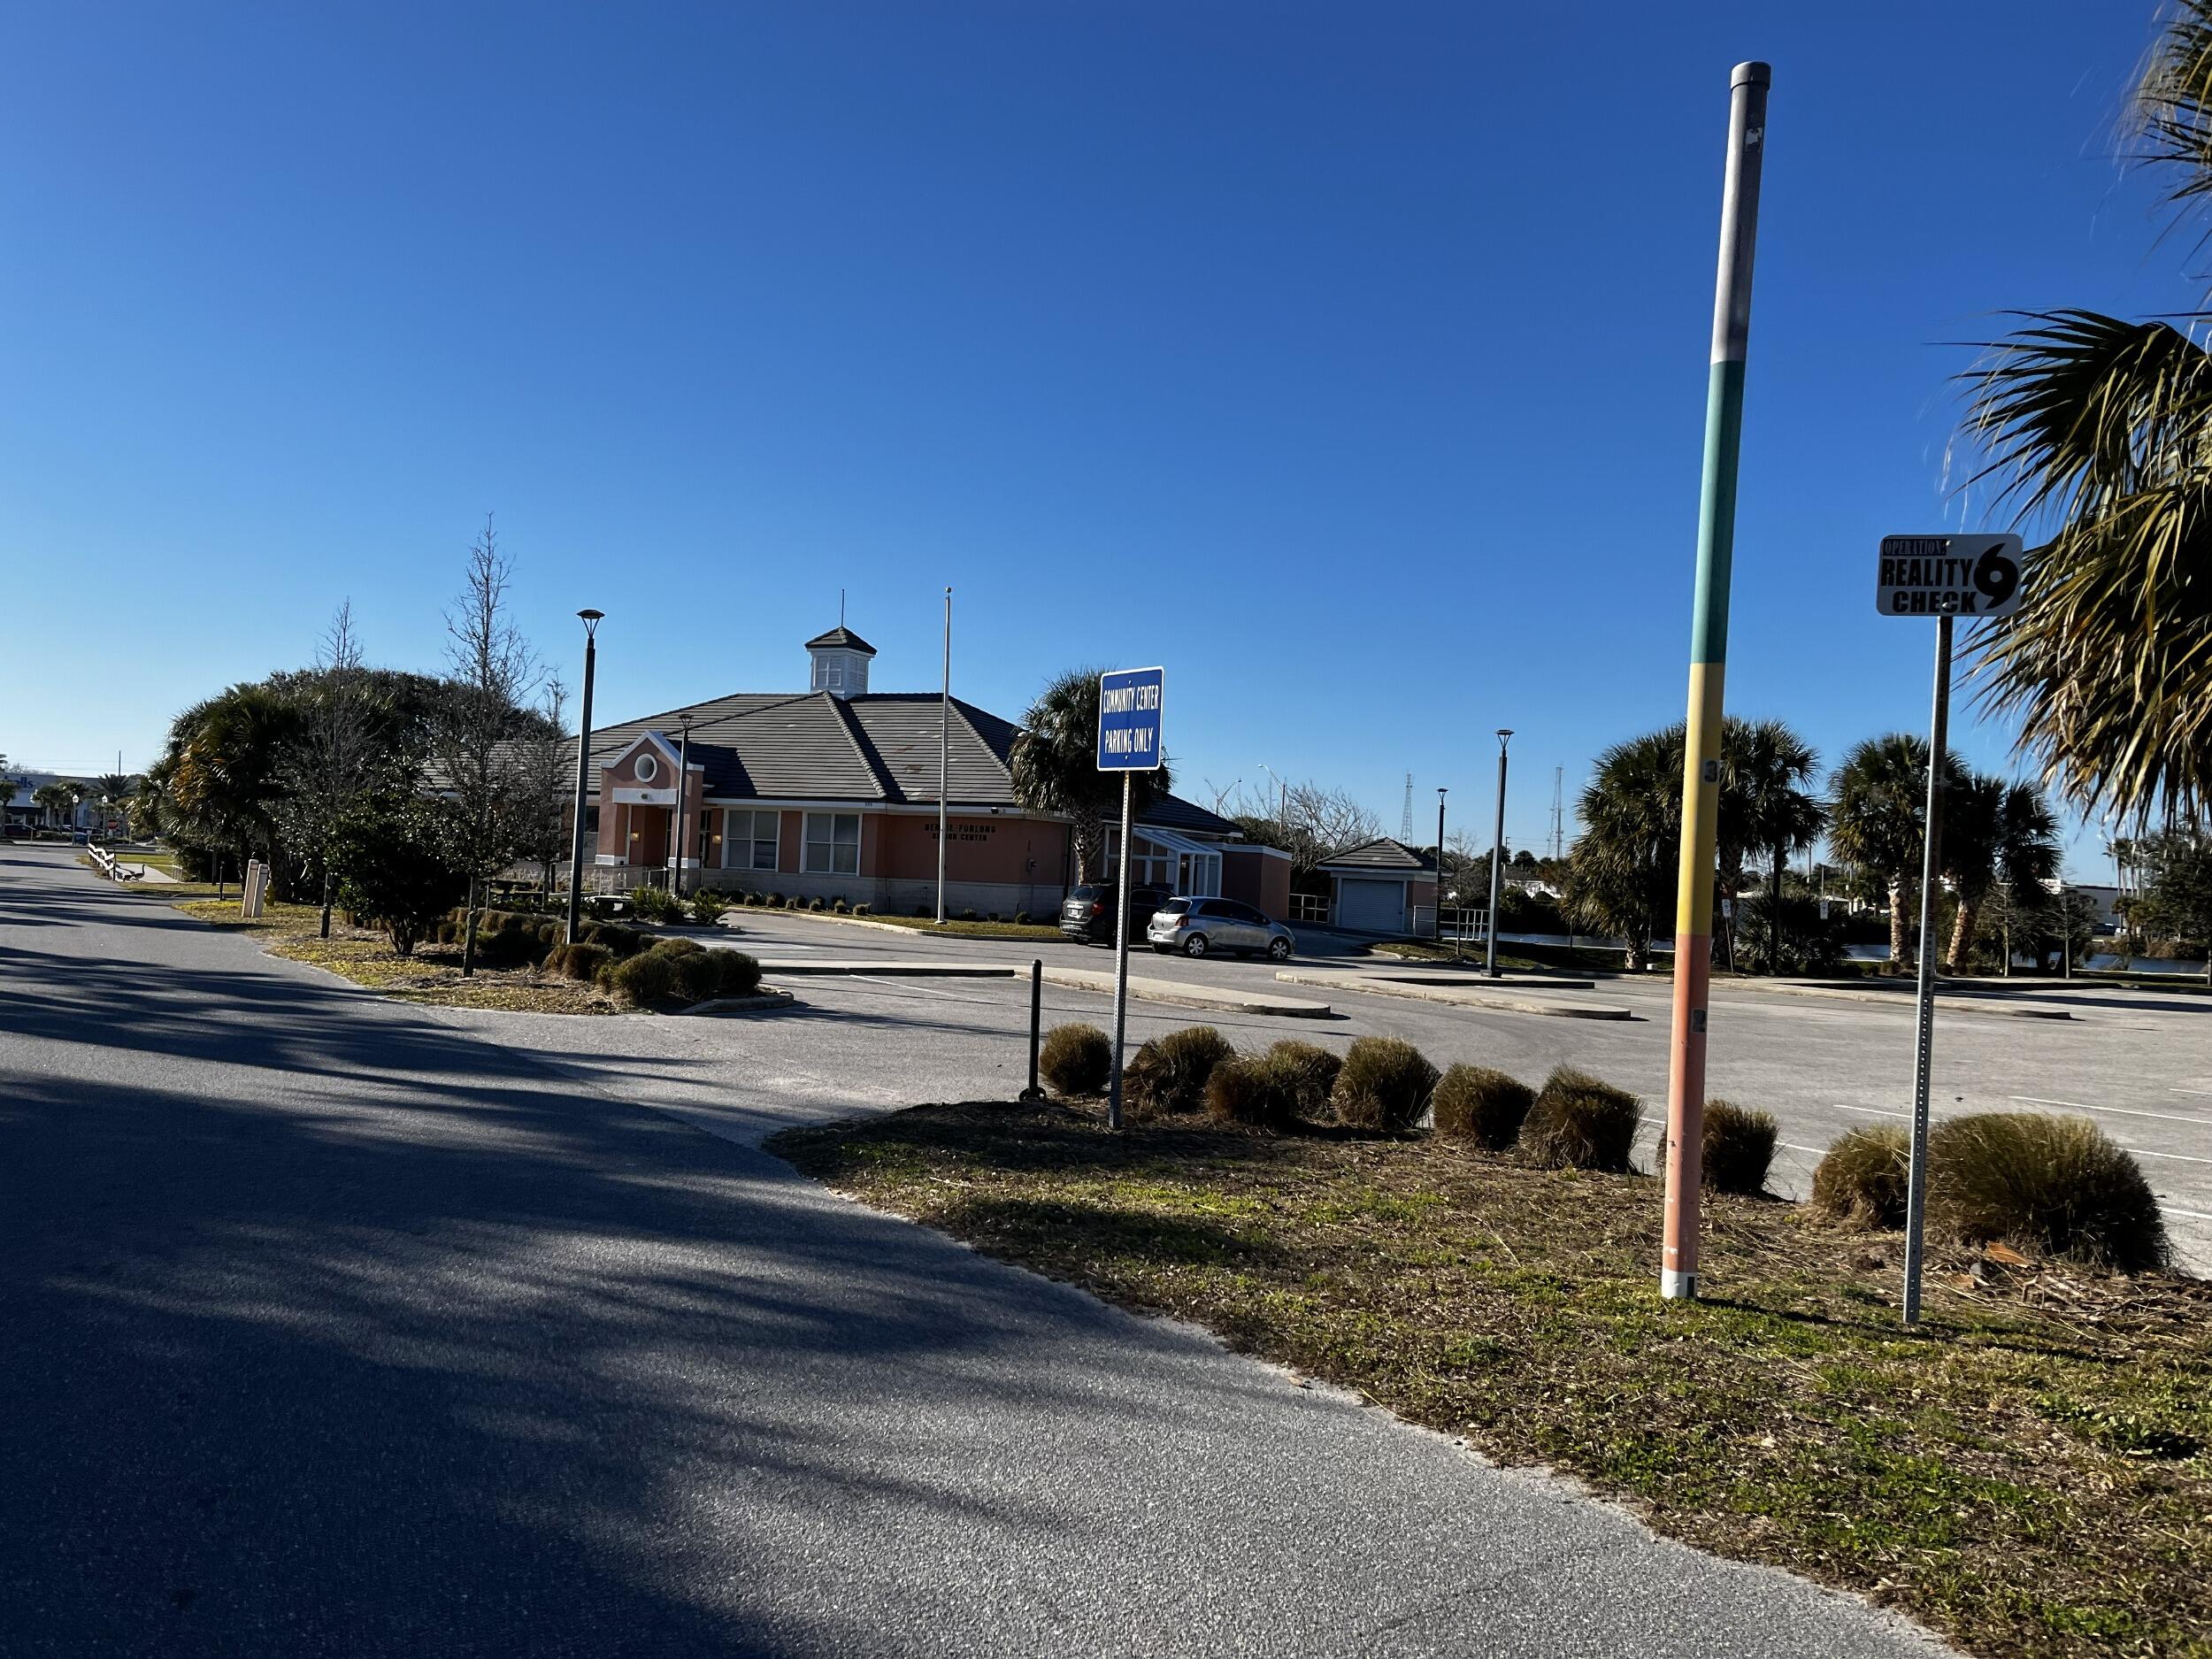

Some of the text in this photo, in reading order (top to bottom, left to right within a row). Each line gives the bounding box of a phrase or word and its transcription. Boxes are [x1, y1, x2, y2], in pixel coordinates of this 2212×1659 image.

[1881, 558, 1973, 586] REALITY
[1893, 590, 1978, 613] CHECK
[1103, 685, 1159, 713] COMMUNITY CENTER
[1105, 727, 1154, 753] PARKING ONLY
[959, 824, 996, 833] FURLONG
